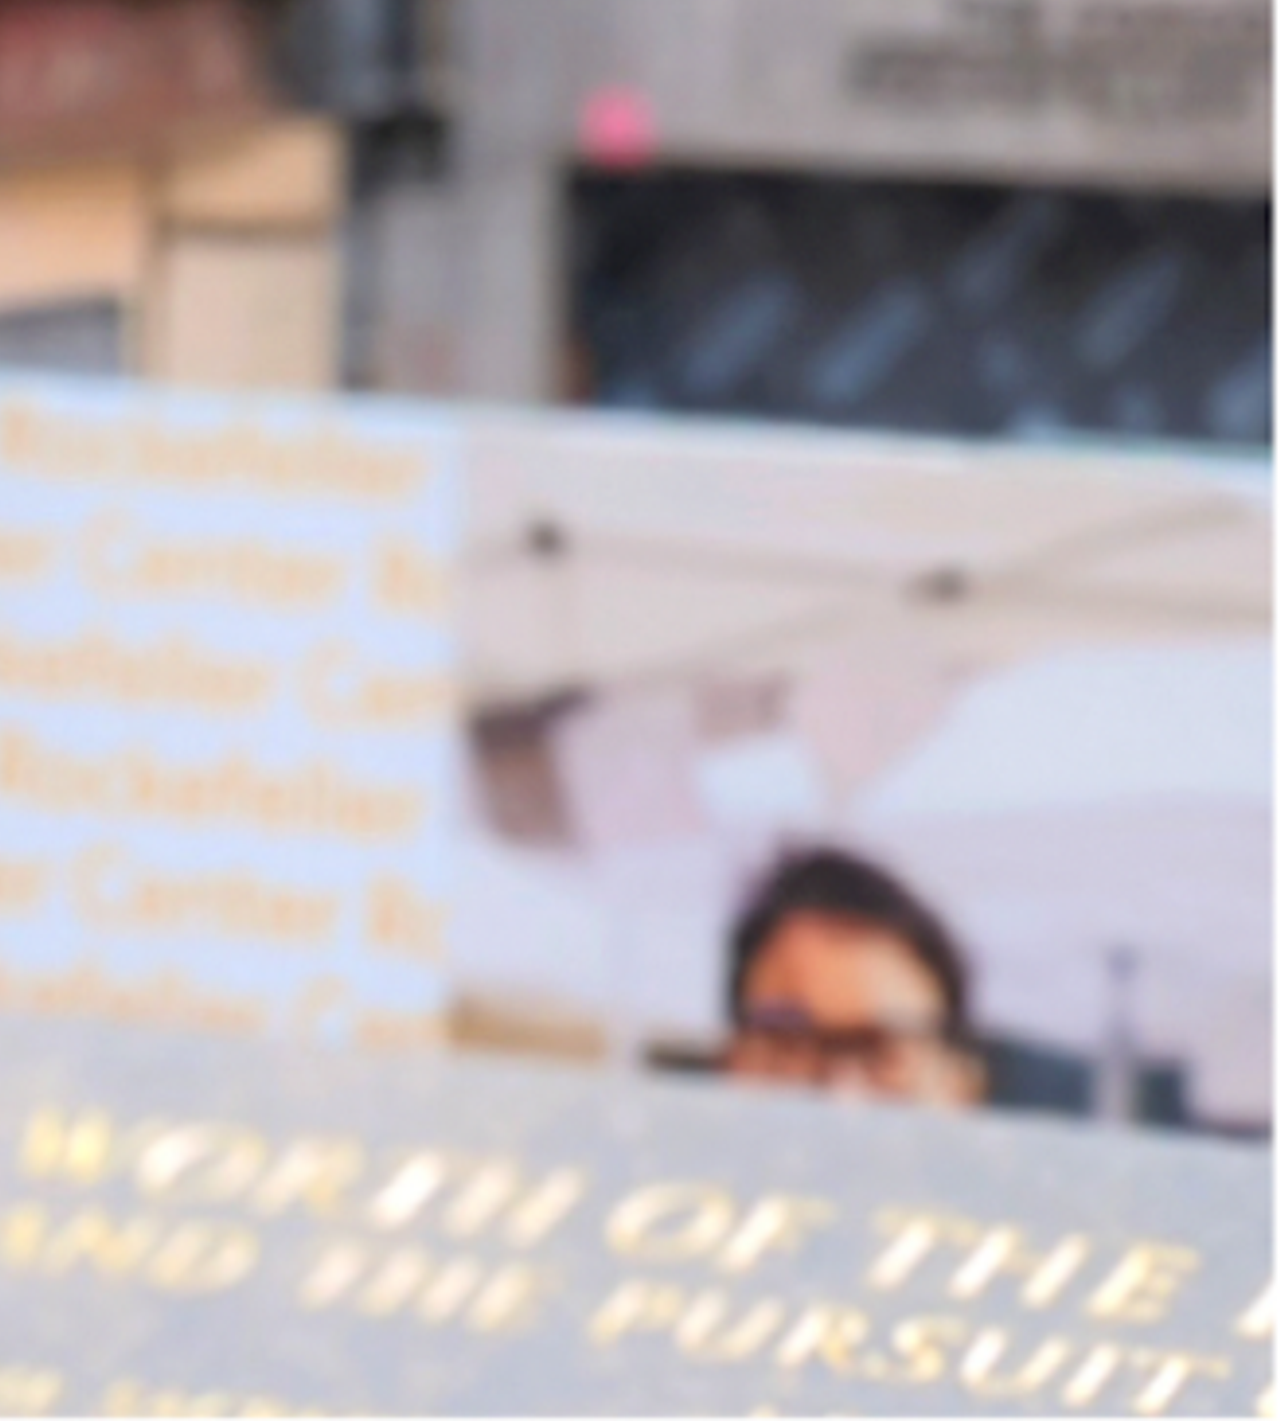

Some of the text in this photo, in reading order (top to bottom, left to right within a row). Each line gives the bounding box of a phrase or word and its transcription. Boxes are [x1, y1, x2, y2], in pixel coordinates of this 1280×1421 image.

[600, 1178, 840, 1276] OF
[864, 1202, 1204, 1325] THE
[585, 1277, 1234, 1417] PURSUIT
